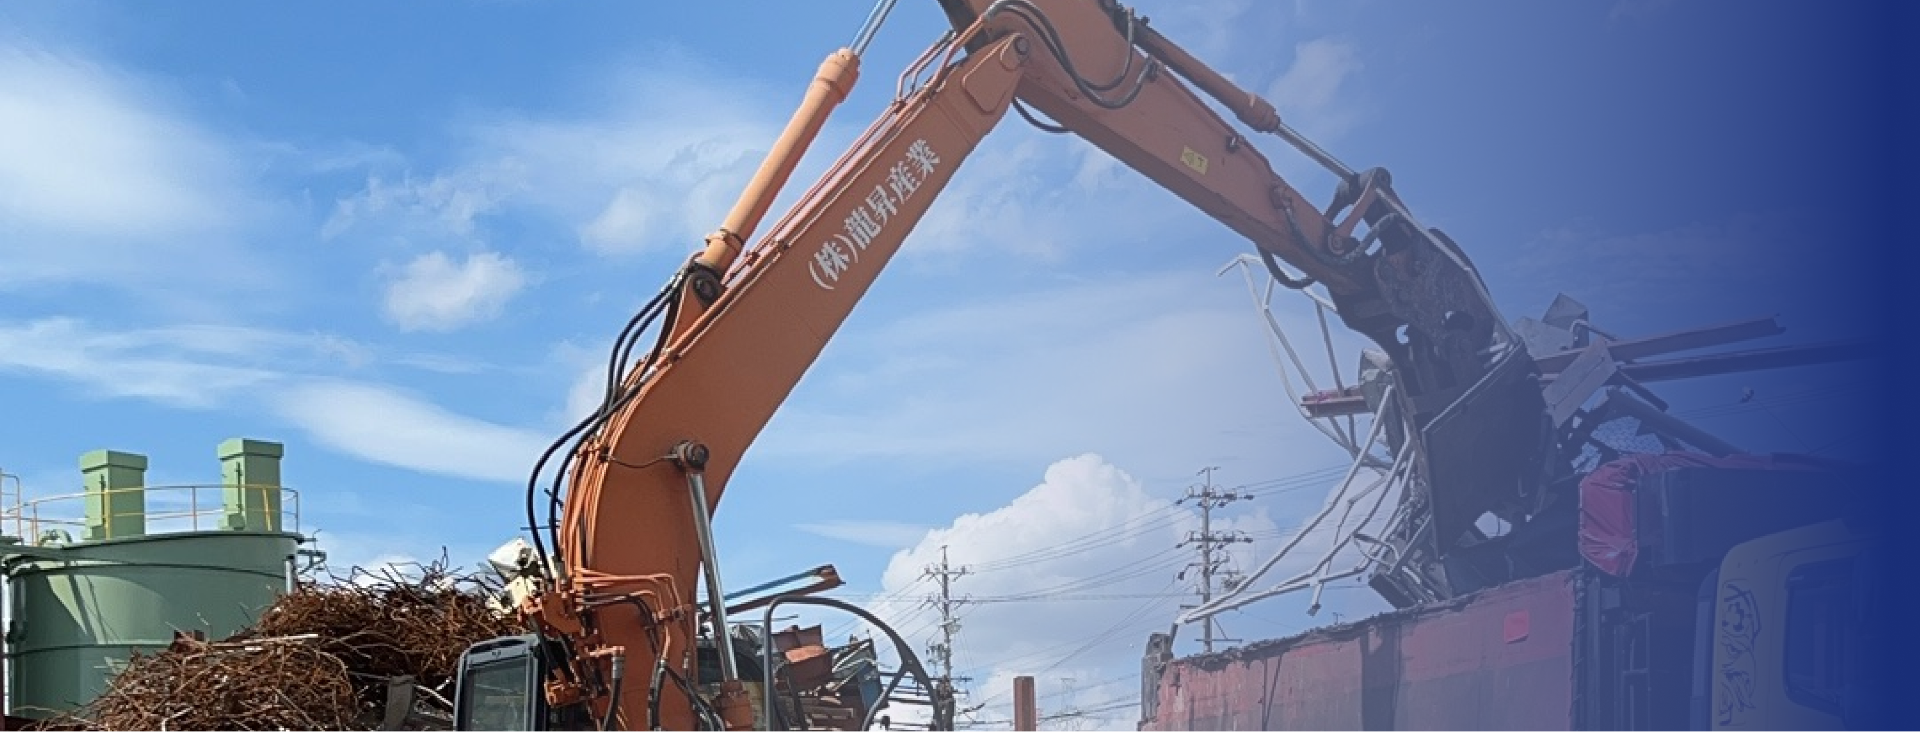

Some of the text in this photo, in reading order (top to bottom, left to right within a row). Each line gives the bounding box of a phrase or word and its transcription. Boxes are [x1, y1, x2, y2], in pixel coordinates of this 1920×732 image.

[809, 139, 940, 289] (株)龍昇産業
